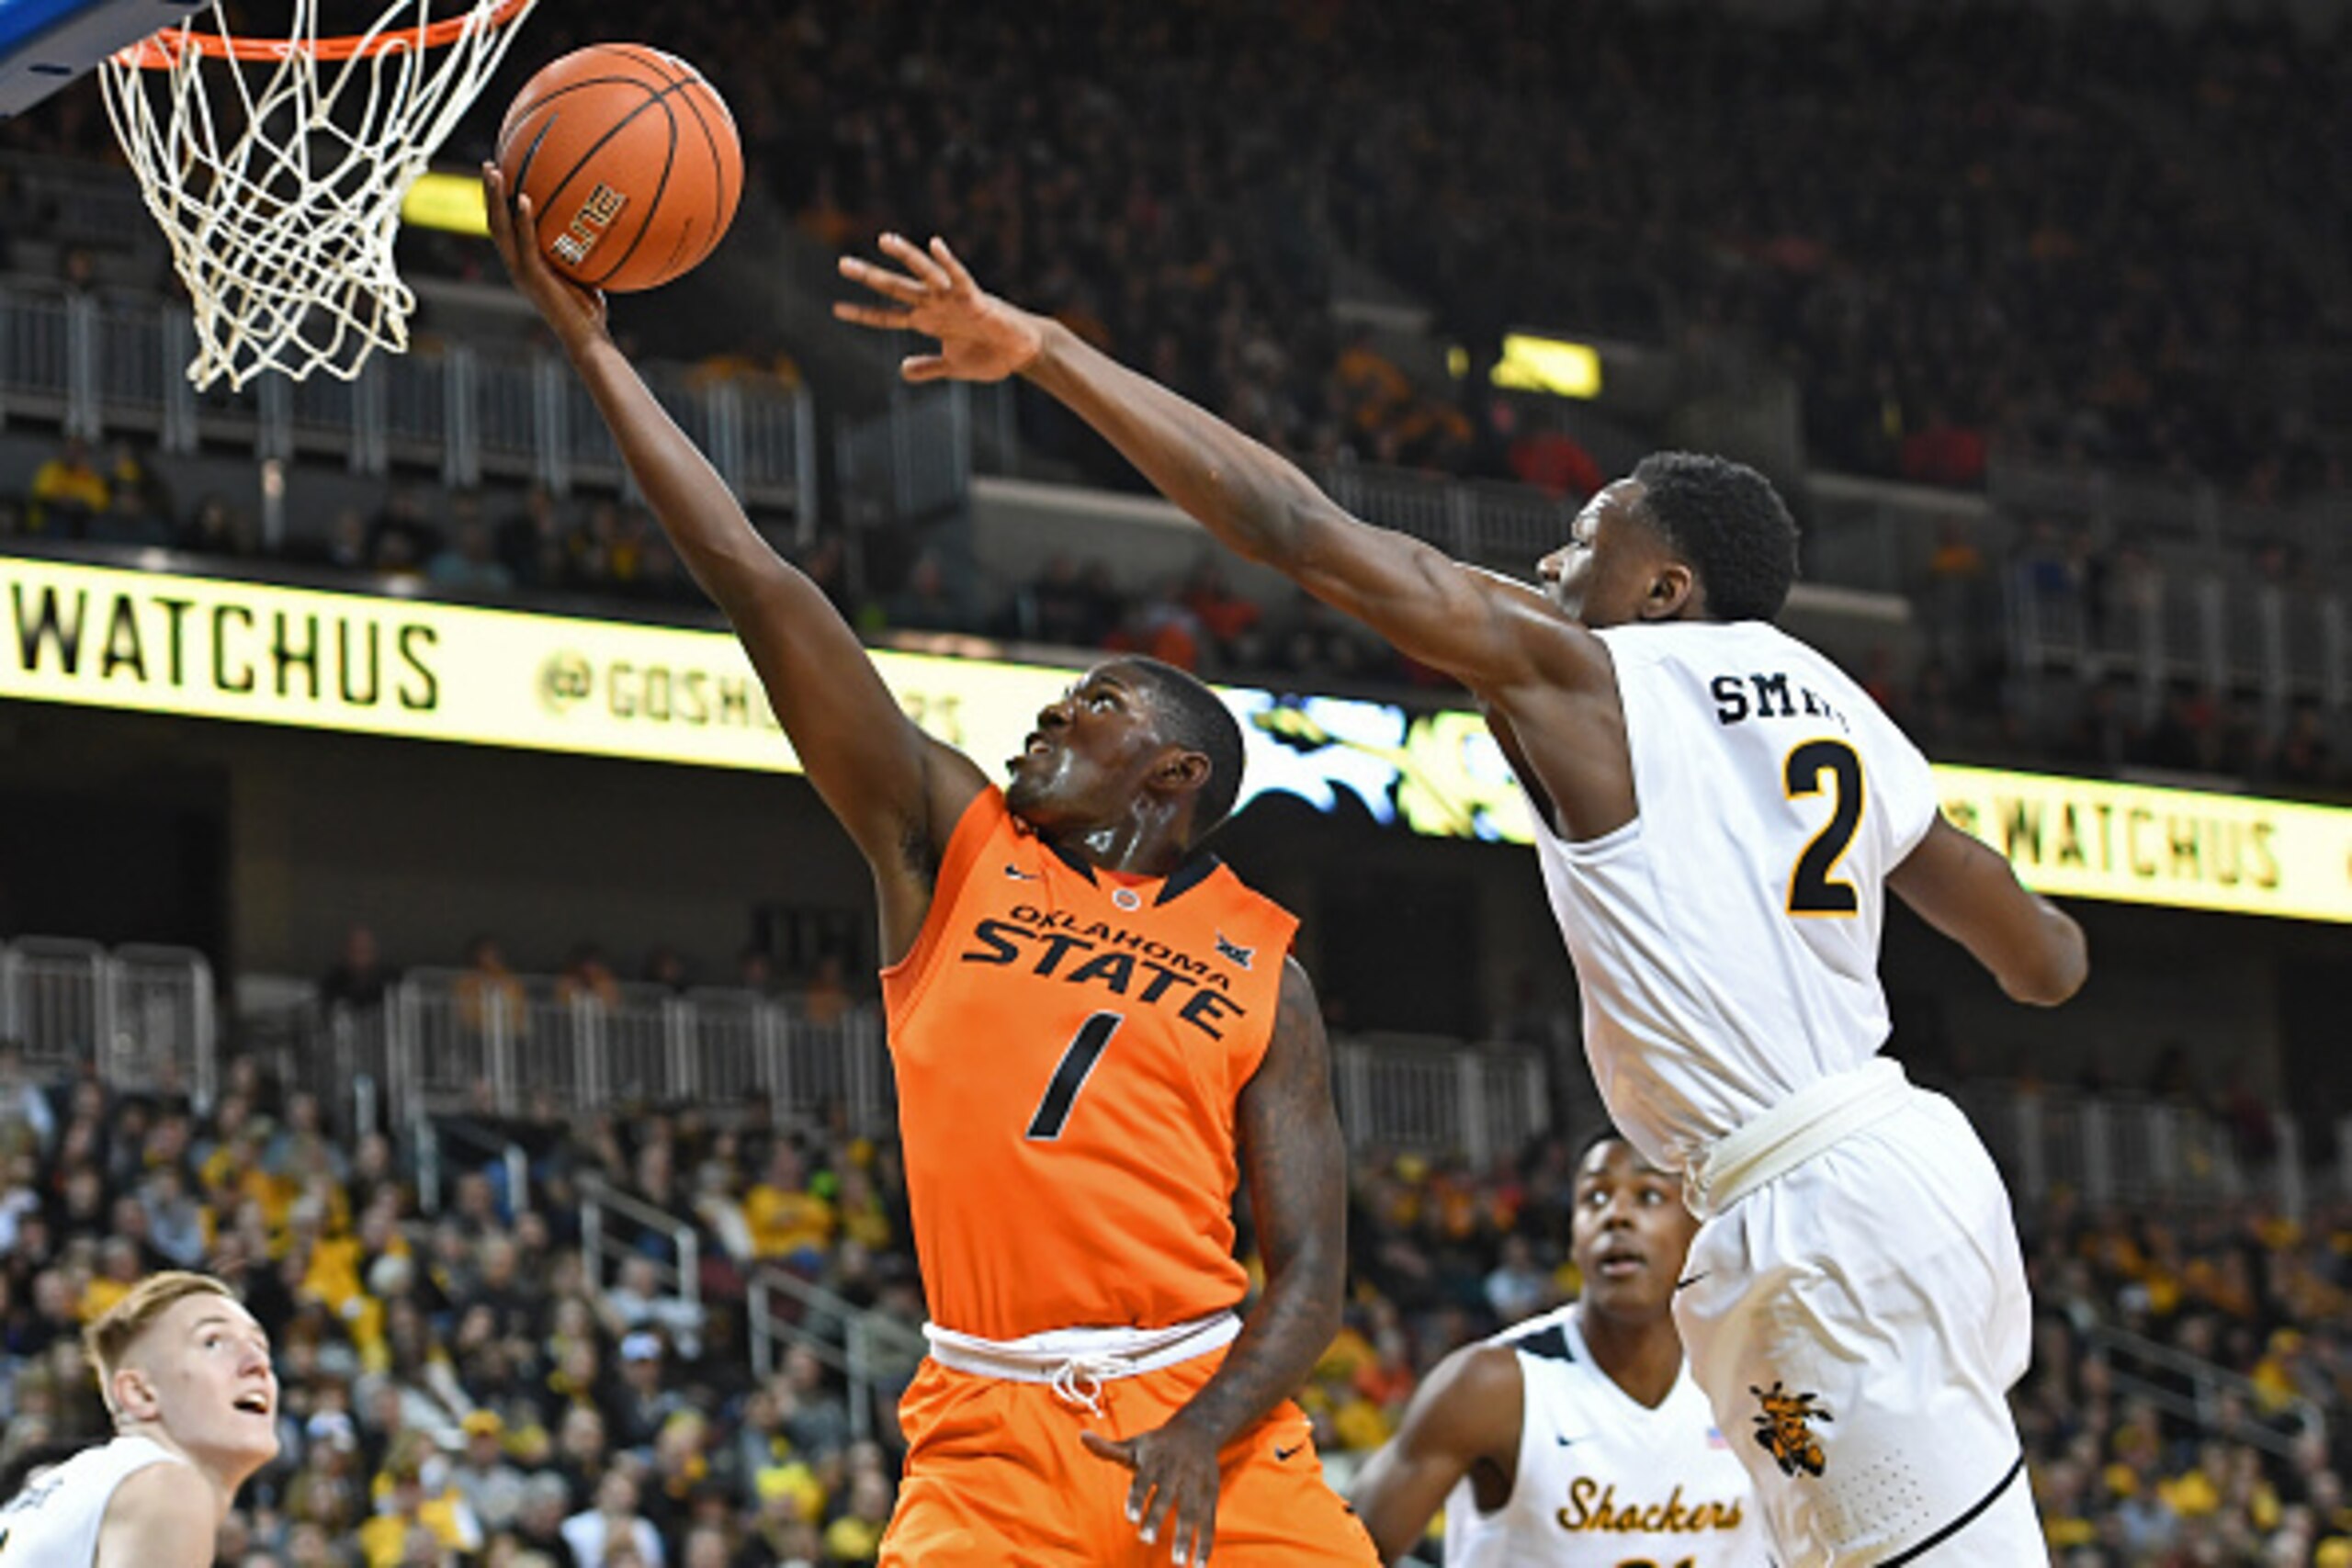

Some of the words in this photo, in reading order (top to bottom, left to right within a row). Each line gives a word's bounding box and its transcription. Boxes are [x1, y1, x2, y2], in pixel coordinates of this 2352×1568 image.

[11, 581, 439, 710] WATCHUS
[1782, 738, 1866, 917] 2
[961, 919, 1247, 1042] STATE
[1010, 905, 1232, 991] OKLAHOMA
[1024, 1008, 1125, 1141] 1
[1556, 1475, 1744, 1533] Shockers
